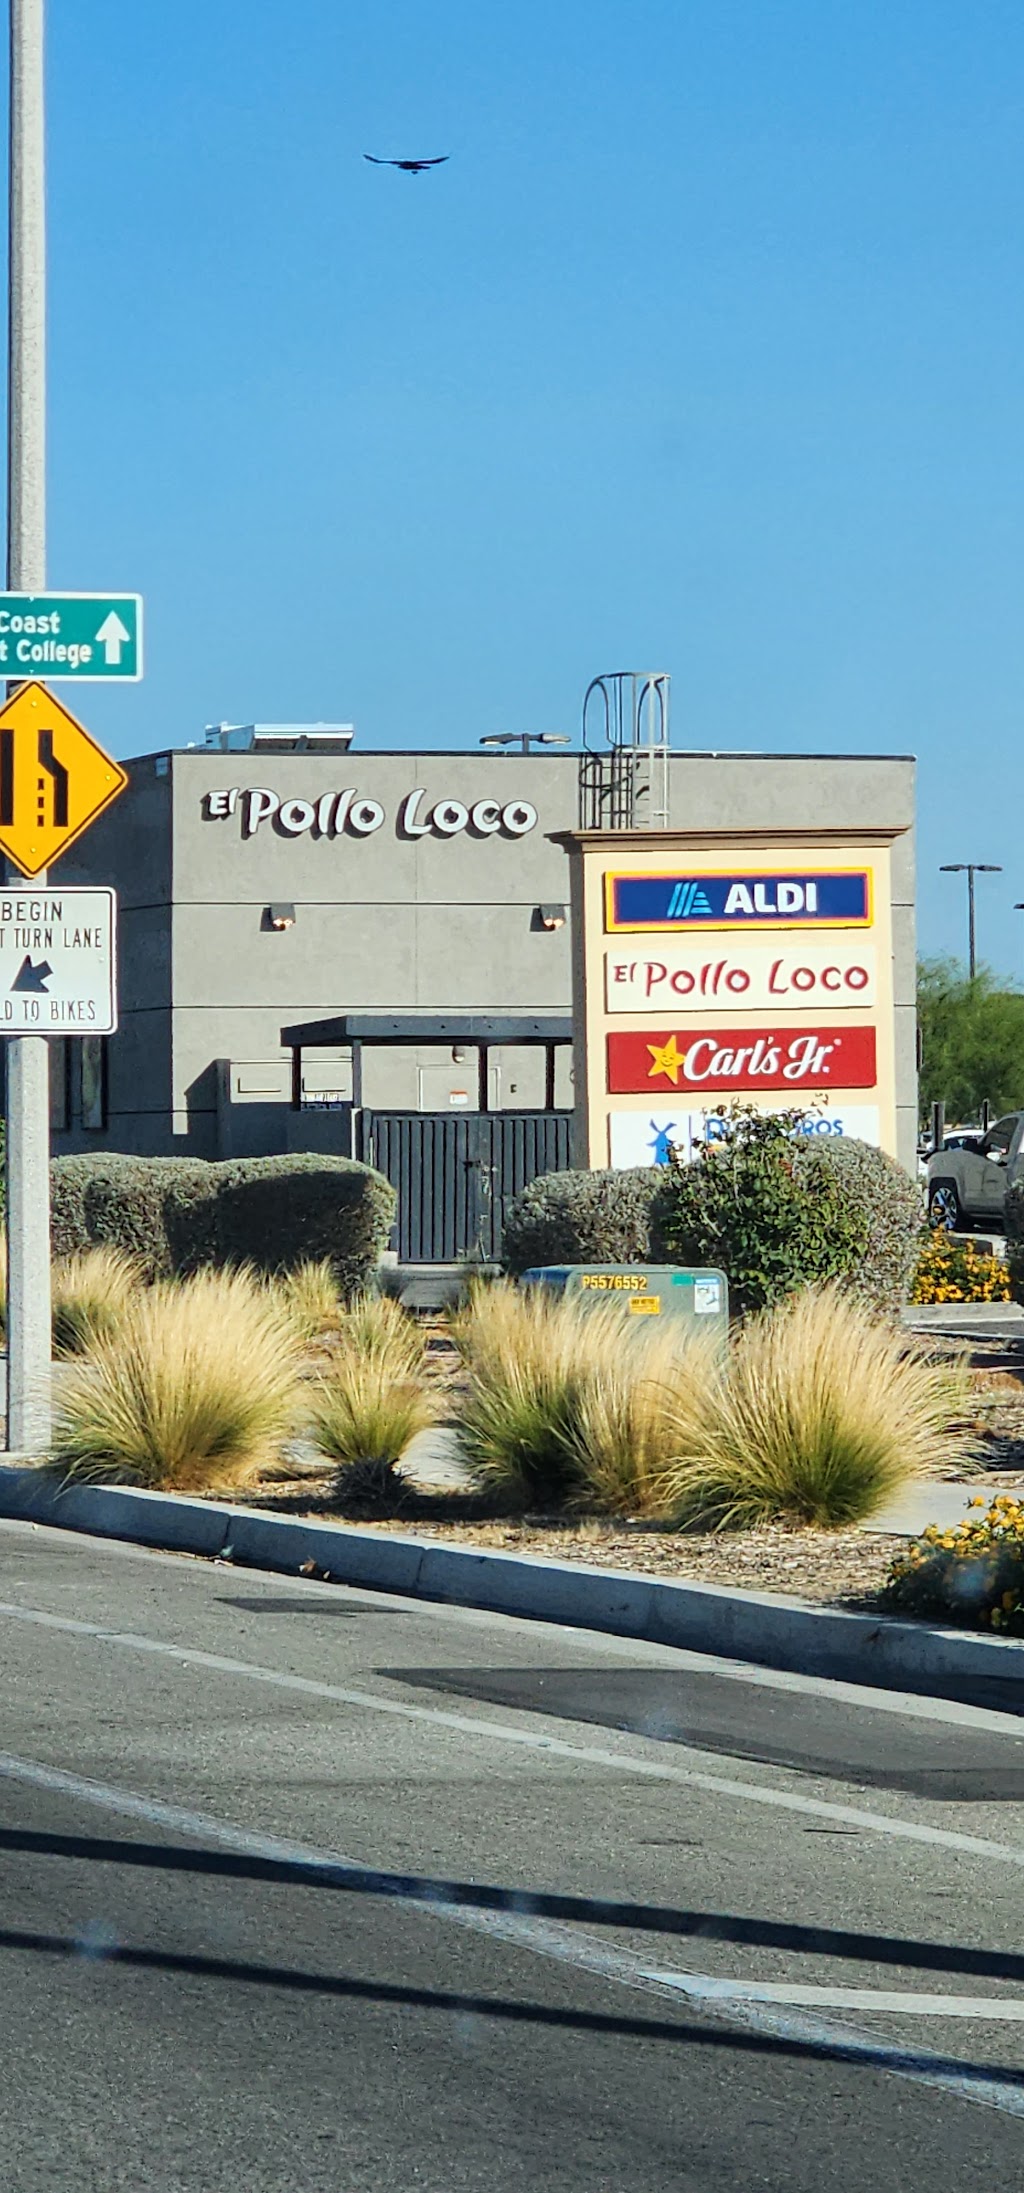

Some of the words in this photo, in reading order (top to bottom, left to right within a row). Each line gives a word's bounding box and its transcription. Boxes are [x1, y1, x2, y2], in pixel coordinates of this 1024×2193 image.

[0, 610, 60, 634] Coast
[16, 638, 92, 669] College
[208, 788, 240, 815] El
[247, 788, 385, 834] Pollo
[402, 788, 538, 834] Loco
[2, 901, 63, 922] BEGIN
[723, 882, 817, 914] ALDI
[14, 927, 53, 949] TURN
[63, 927, 102, 948] LANE
[613, 962, 637, 983] El
[643, 960, 750, 997] Pollo
[768, 959, 869, 995] Loco
[21, 1000, 40, 1021] TO
[50, 1000, 96, 1021] BIKES
[682, 1036, 782, 1081] Carl's
[782, 1036, 834, 1080] Jr.
[582, 1275, 647, 1290] P5576552
